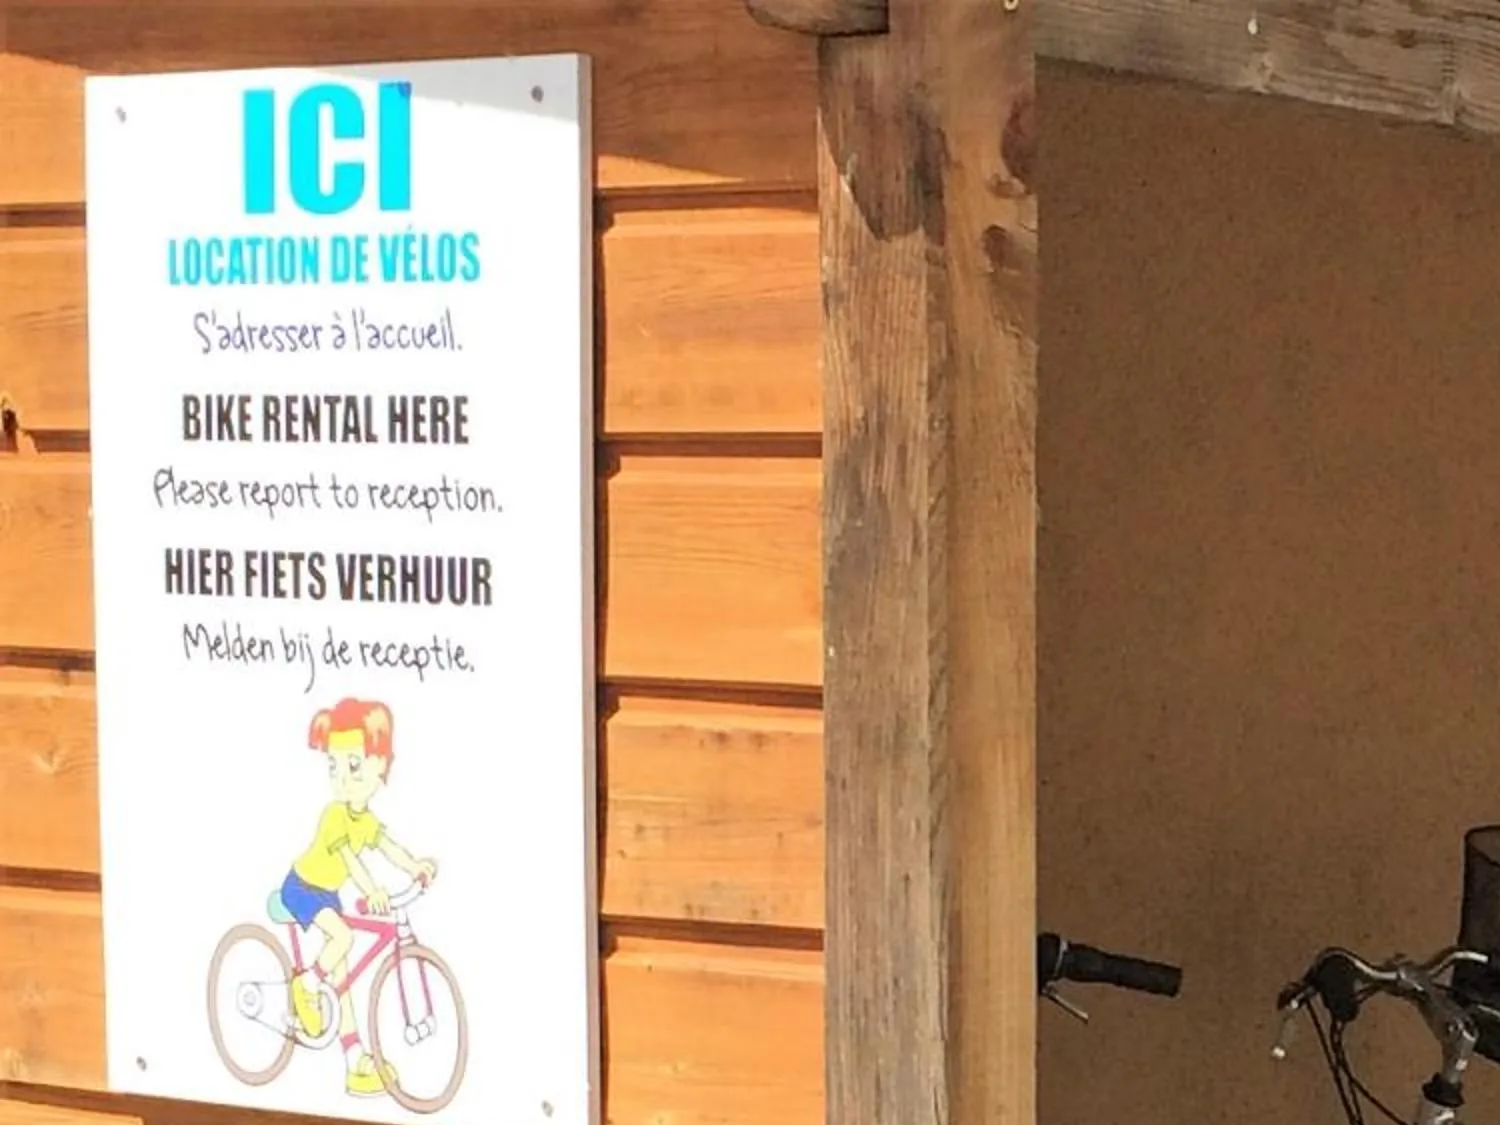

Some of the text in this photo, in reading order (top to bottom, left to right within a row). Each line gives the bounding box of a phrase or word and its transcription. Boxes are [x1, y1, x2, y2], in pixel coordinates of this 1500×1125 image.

[243, 81, 413, 215] ICI
[166, 226, 481, 286] LOCATION DE VÉLOS
[194, 309, 462, 354] S'adresser à l'accueil.
[183, 394, 469, 444] BIKE RENTAL HERE
[153, 466, 502, 523] Please report to reception.
[164, 548, 492, 607] HIER FIETS VERHUUR
[183, 622, 475, 693] Melden bij de receptie.
